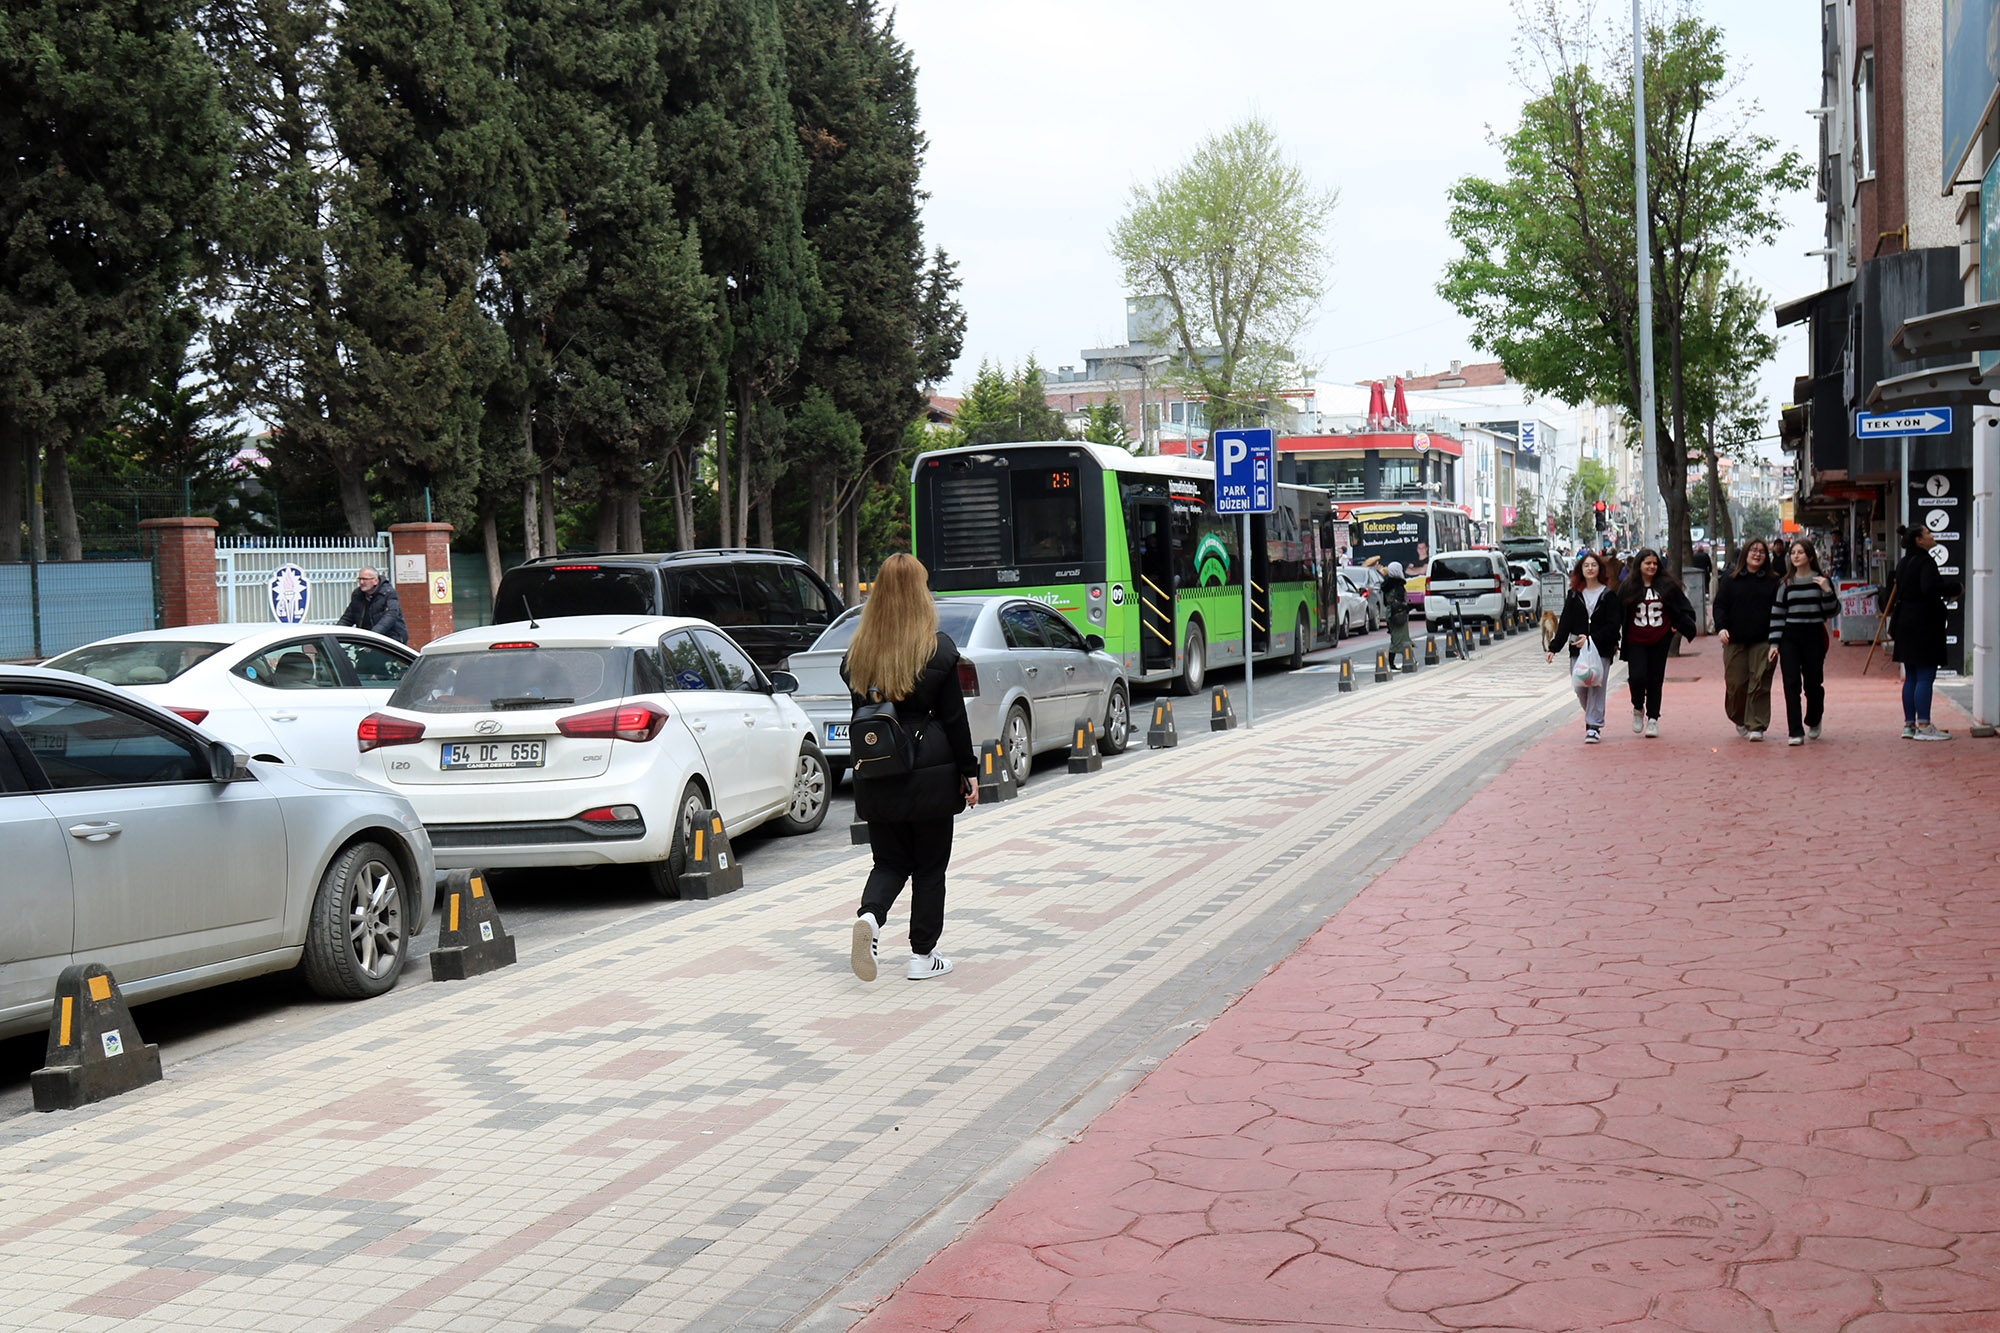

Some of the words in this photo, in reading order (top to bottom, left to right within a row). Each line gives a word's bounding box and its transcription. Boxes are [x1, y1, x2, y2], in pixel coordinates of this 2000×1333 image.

[1867, 421, 1890, 429] TEK
[1896, 417, 1921, 427] YÖN
[1223, 439, 1247, 476] P
[1052, 472, 1070, 488] 25
[1223, 485, 1246, 496] PARK
[1220, 496, 1250, 510] DÜZENİ
[1363, 522, 1395, 533] Kokoreç
[1397, 521, 1418, 531] adam
[1113, 588, 1123, 601] 09
[1634, 602, 1663, 627] 36
[835, 726, 848, 738] 44
[44, 735, 63, 748] 120
[452, 746, 471, 763] 54
[479, 745, 499, 761] DC
[511, 744, 540, 761] 656
